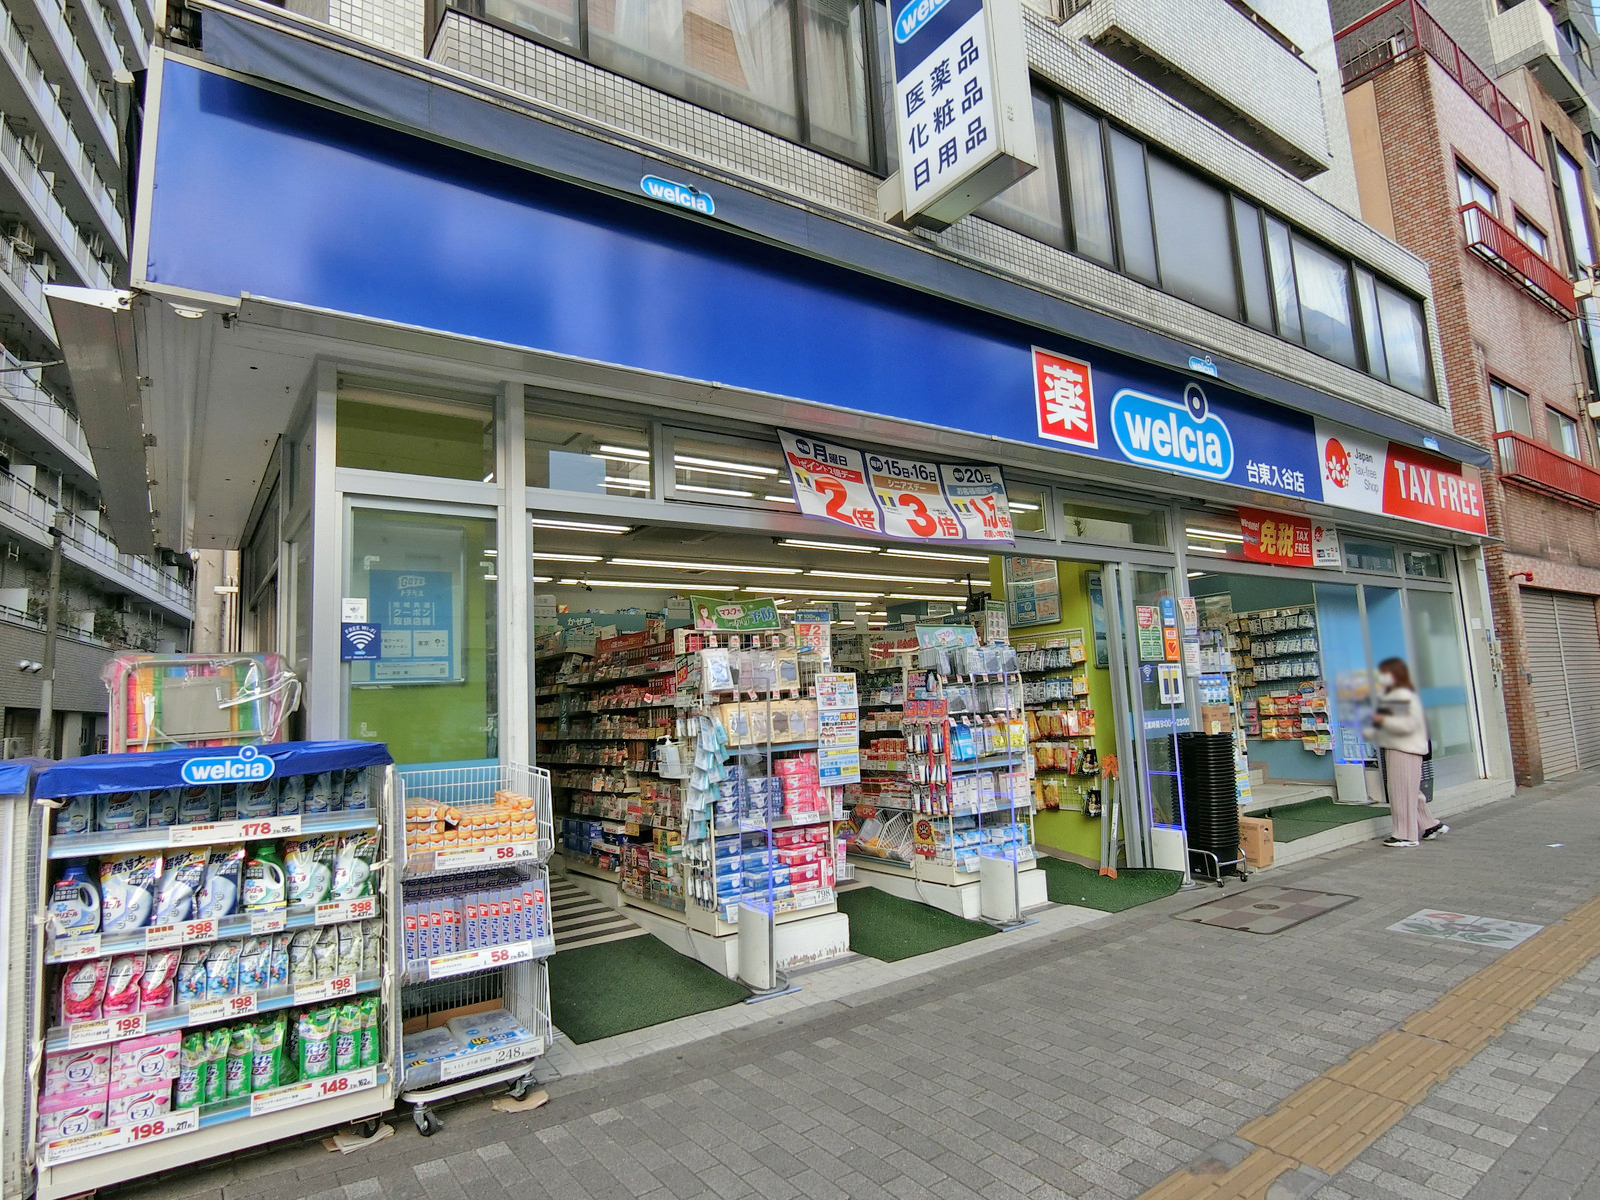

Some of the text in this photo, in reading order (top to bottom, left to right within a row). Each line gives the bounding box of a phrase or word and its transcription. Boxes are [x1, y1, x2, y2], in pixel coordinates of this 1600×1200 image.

[905, 36, 980, 118] 医薬品
[908, 76, 983, 154] 化粧品
[913, 116, 988, 191] 日用品
[647, 181, 708, 212] welcia
[1043, 364, 1089, 432] 薬
[1123, 411, 1223, 468] welcia
[812, 443, 848, 466] 月曜日
[1354, 448, 1374, 463] Japan
[1245, 459, 1305, 494] 台東入谷店
[1353, 463, 1378, 480] Tax-free
[1364, 478, 1379, 495] Shop
[1393, 459, 1480, 517] TAX FREE
[1260, 519, 1295, 557] 免税
[1295, 530, 1309, 542] TAX
[1294, 542, 1311, 553] FREE
[400, 589, 424, 597] トラベル
[393, 608, 431, 617] クーポン
[750, 607, 775, 624] 予防
[344, 625, 377, 634] FREE Wi-Fi
[191, 760, 265, 780] welcia
[241, 822, 272, 836] 178
[496, 846, 514, 859] 58
[815, 889, 831, 898] 798
[349, 901, 372, 913] 398
[186, 921, 213, 936] 398
[490, 949, 509, 963] 58
[330, 977, 351, 990] 198
[230, 996, 252, 1009] 198
[116, 1017, 141, 1031] 198
[470, 1036, 490, 1045] 45
[497, 1046, 521, 1060] 248
[68, 1066, 88, 1078] ビーズ
[140, 1061, 160, 1073] ビーズ
[320, 1077, 348, 1095] 148
[130, 1108, 150, 1120] ビーズ
[62, 1123, 83, 1134] ビーズ
[130, 1120, 165, 1141] 198
